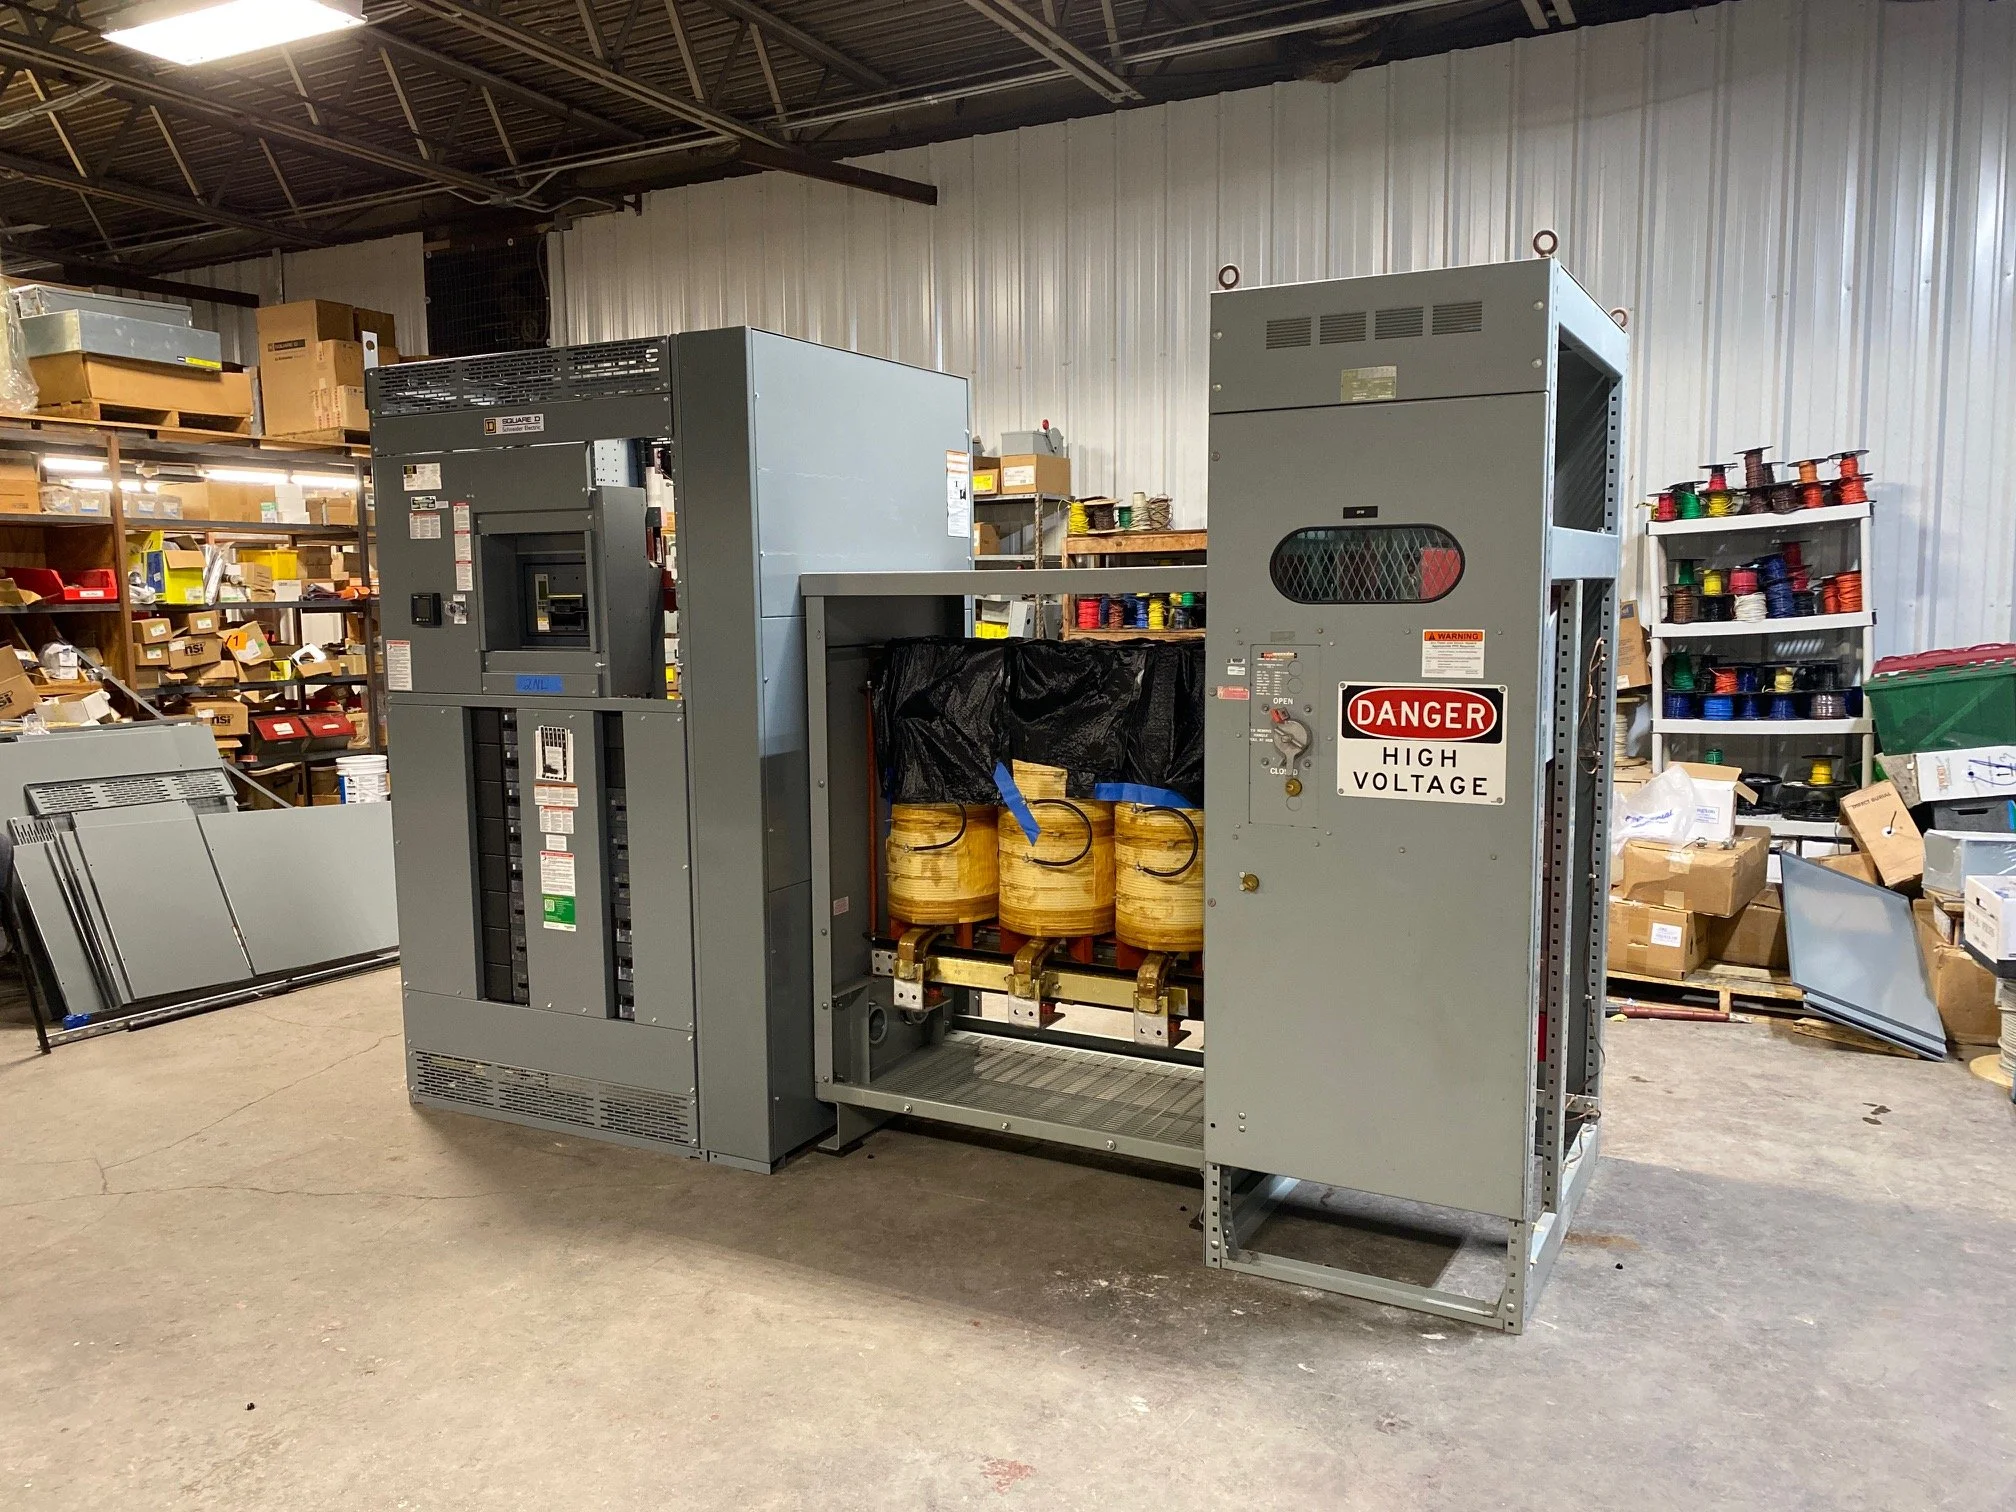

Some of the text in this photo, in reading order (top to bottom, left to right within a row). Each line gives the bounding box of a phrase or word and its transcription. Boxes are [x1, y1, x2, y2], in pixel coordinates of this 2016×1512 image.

[1357, 700, 1486, 730] DANGER
[1382, 747, 1457, 768] HIGH
[1353, 771, 1488, 796] VOLTAGE
